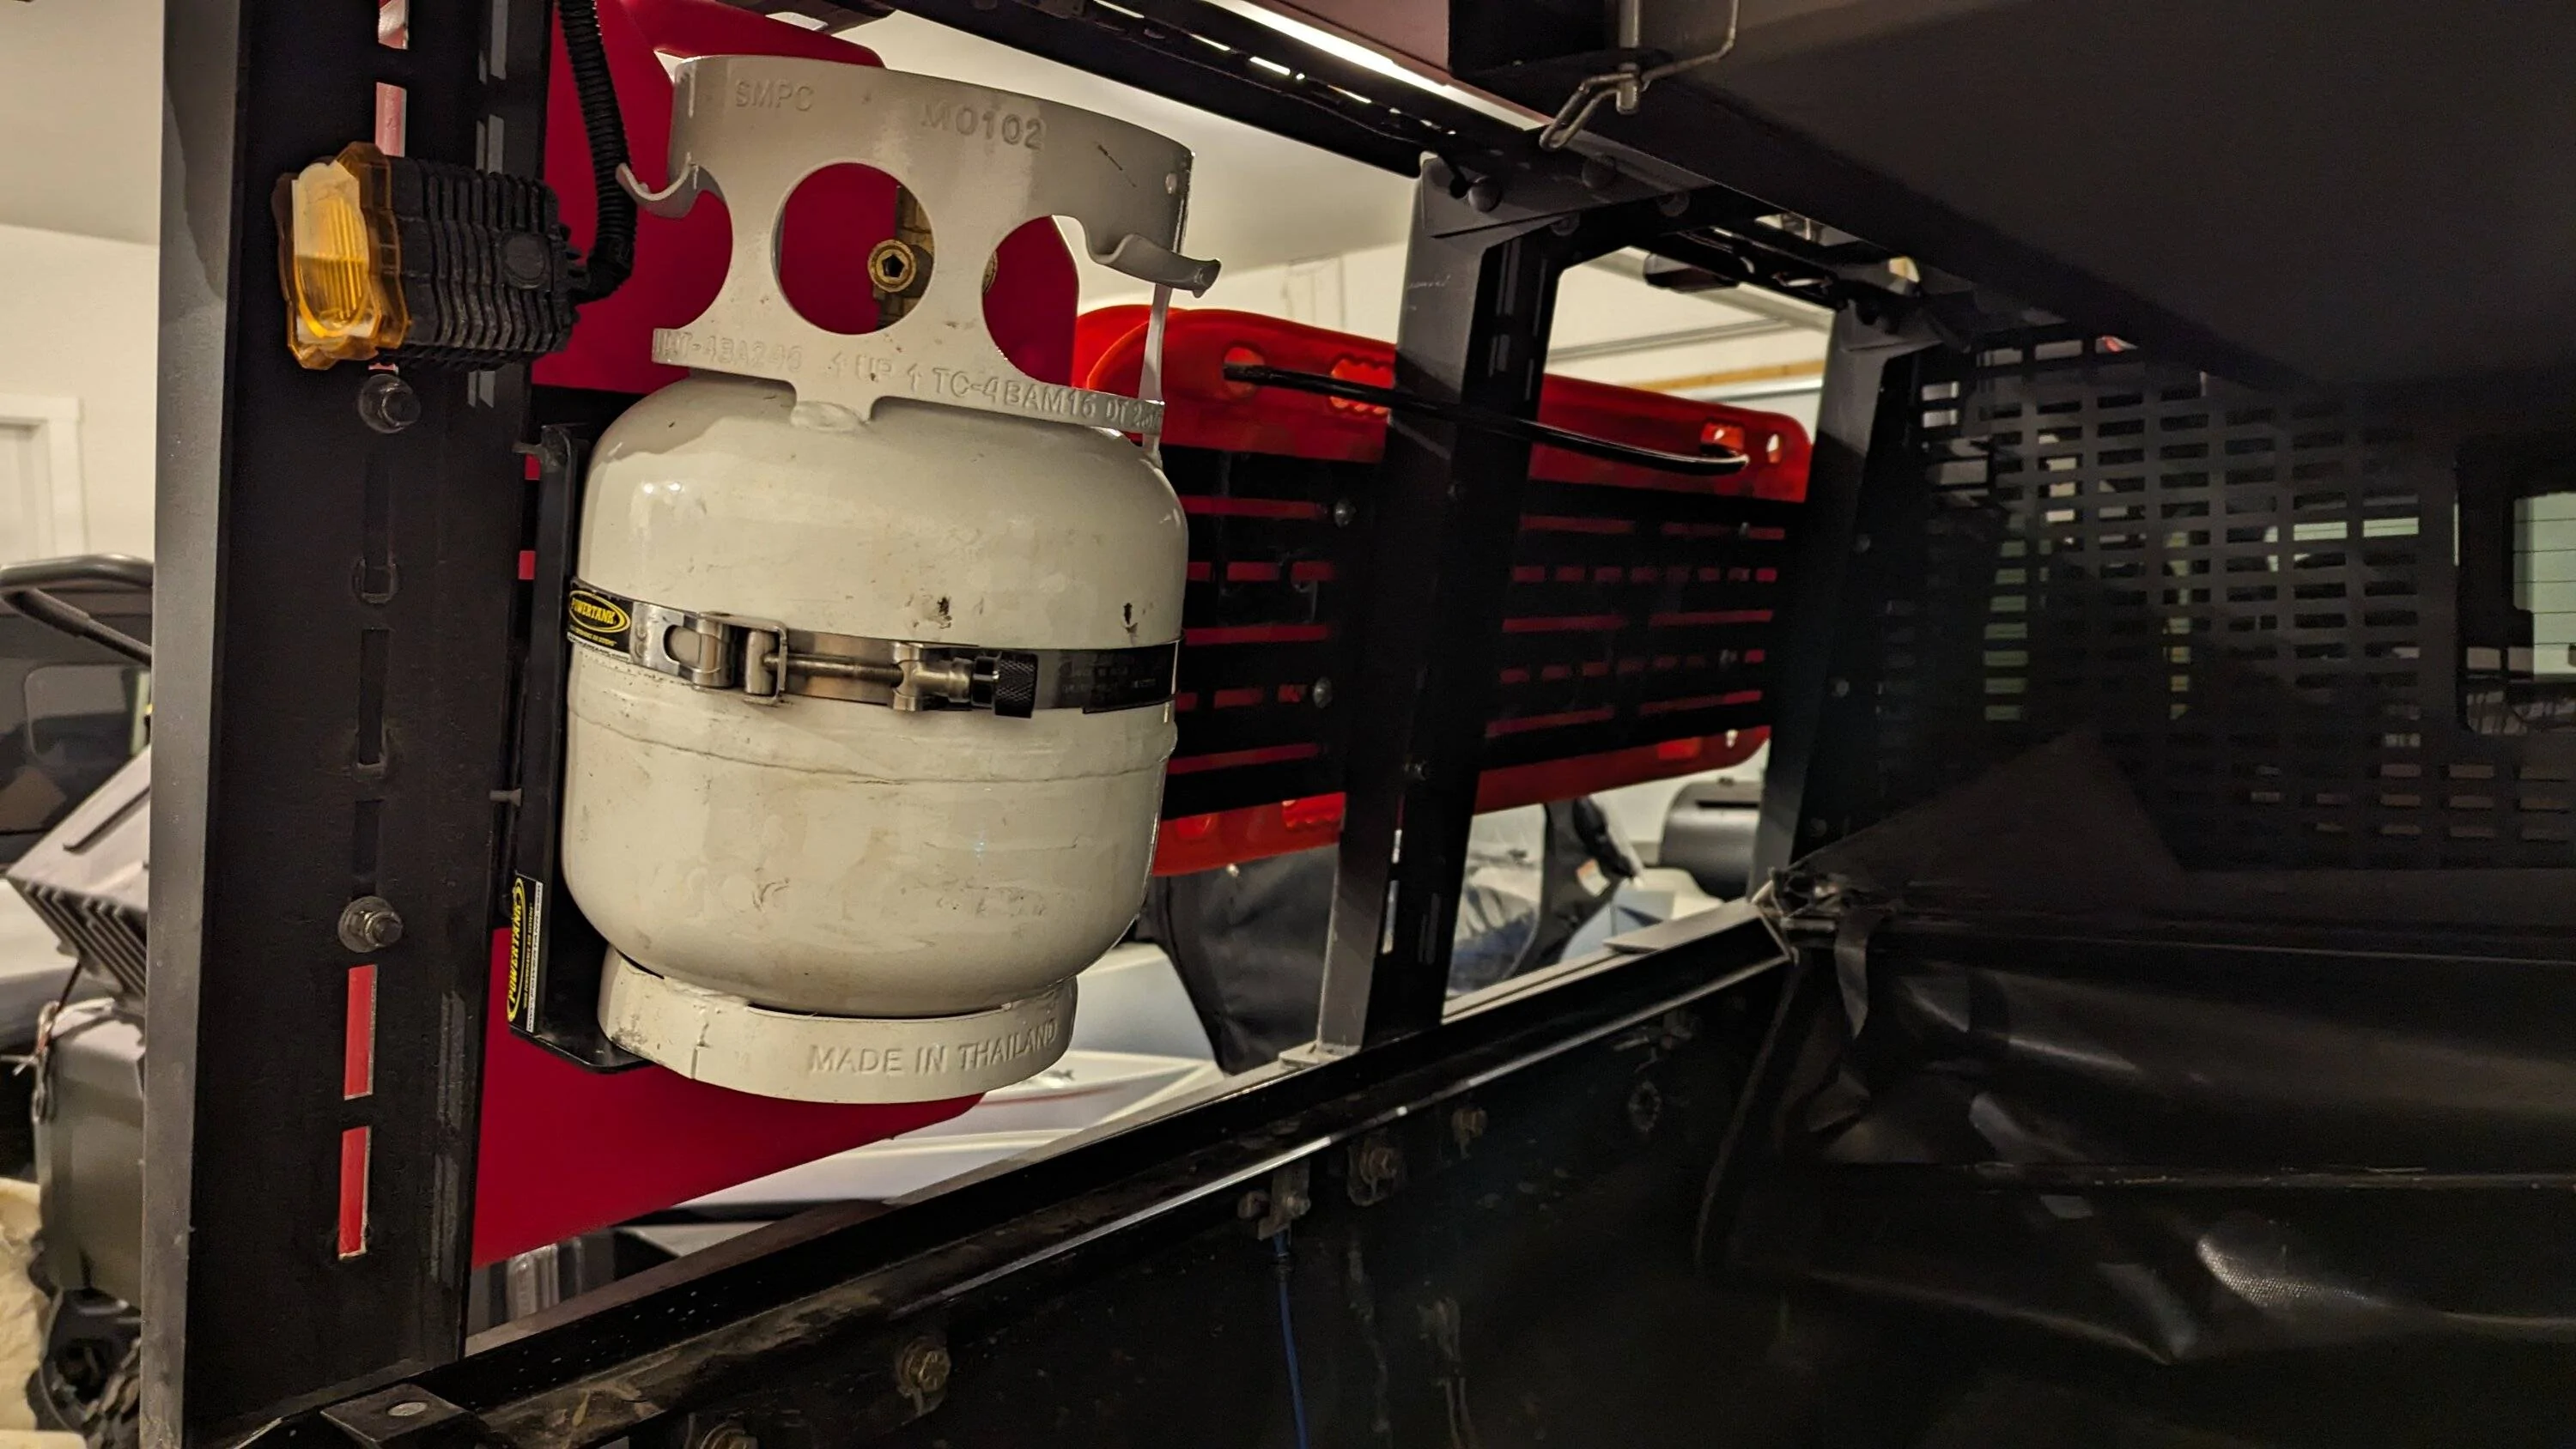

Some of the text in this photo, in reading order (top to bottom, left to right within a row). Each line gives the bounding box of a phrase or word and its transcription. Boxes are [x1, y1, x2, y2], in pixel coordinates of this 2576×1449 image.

[735, 79, 814, 112] SMPC
[508, 904, 521, 1003] POWERTANK
[807, 1017, 1058, 1074] MADE IN THAILAND
